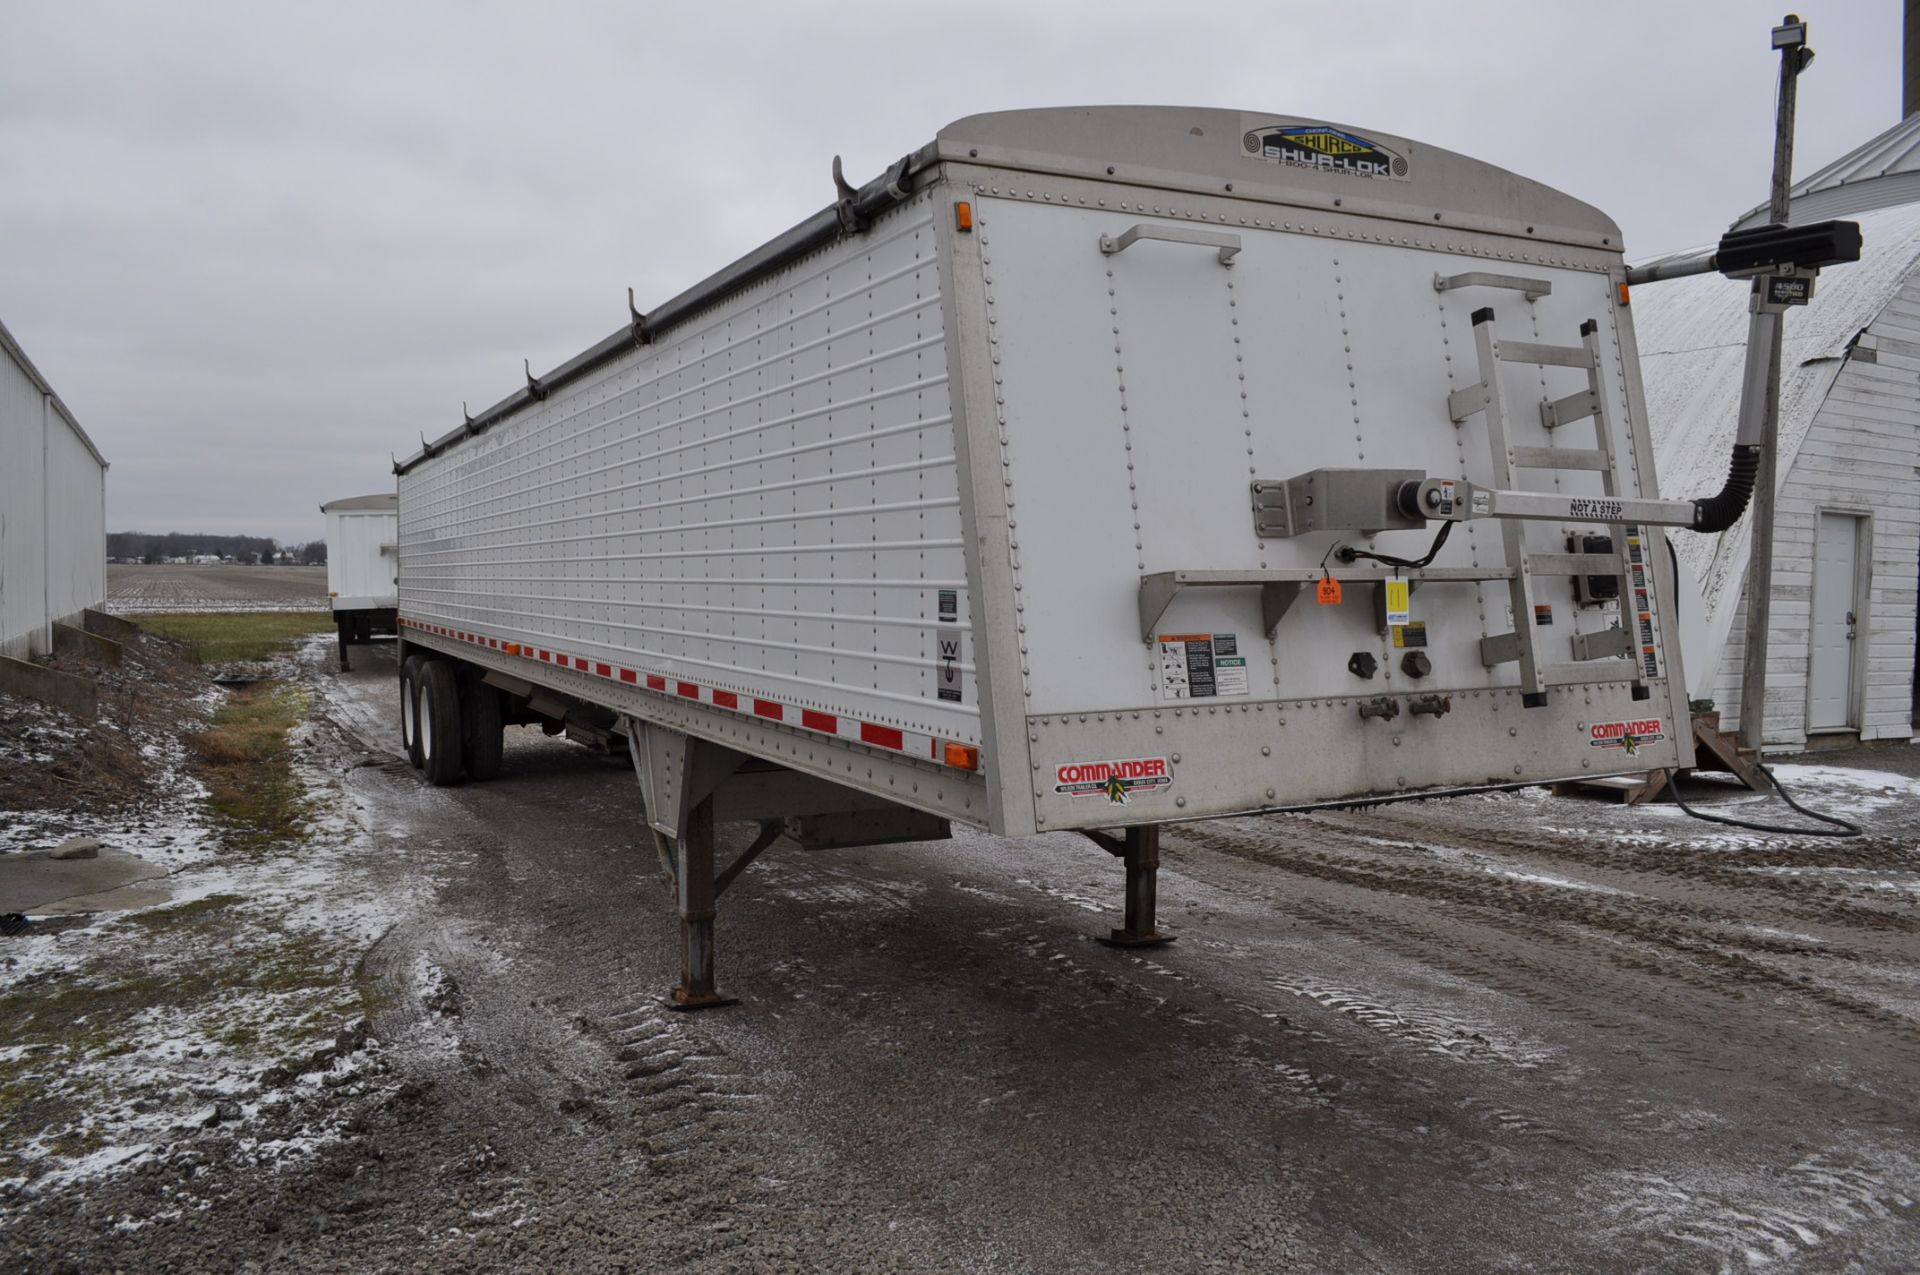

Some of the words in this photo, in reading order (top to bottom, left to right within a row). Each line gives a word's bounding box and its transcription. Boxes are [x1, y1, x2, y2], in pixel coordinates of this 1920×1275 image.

[1294, 133, 1362, 154] SHURCO
[1264, 146, 1389, 176] SHUR-LOK
[1570, 503, 1588, 513] NOT
[1591, 504, 1598, 513] A
[1600, 505, 1622, 515] STEP
[1591, 720, 1661, 738] COMMANDER
[1058, 759, 1166, 783] COMMANDER
